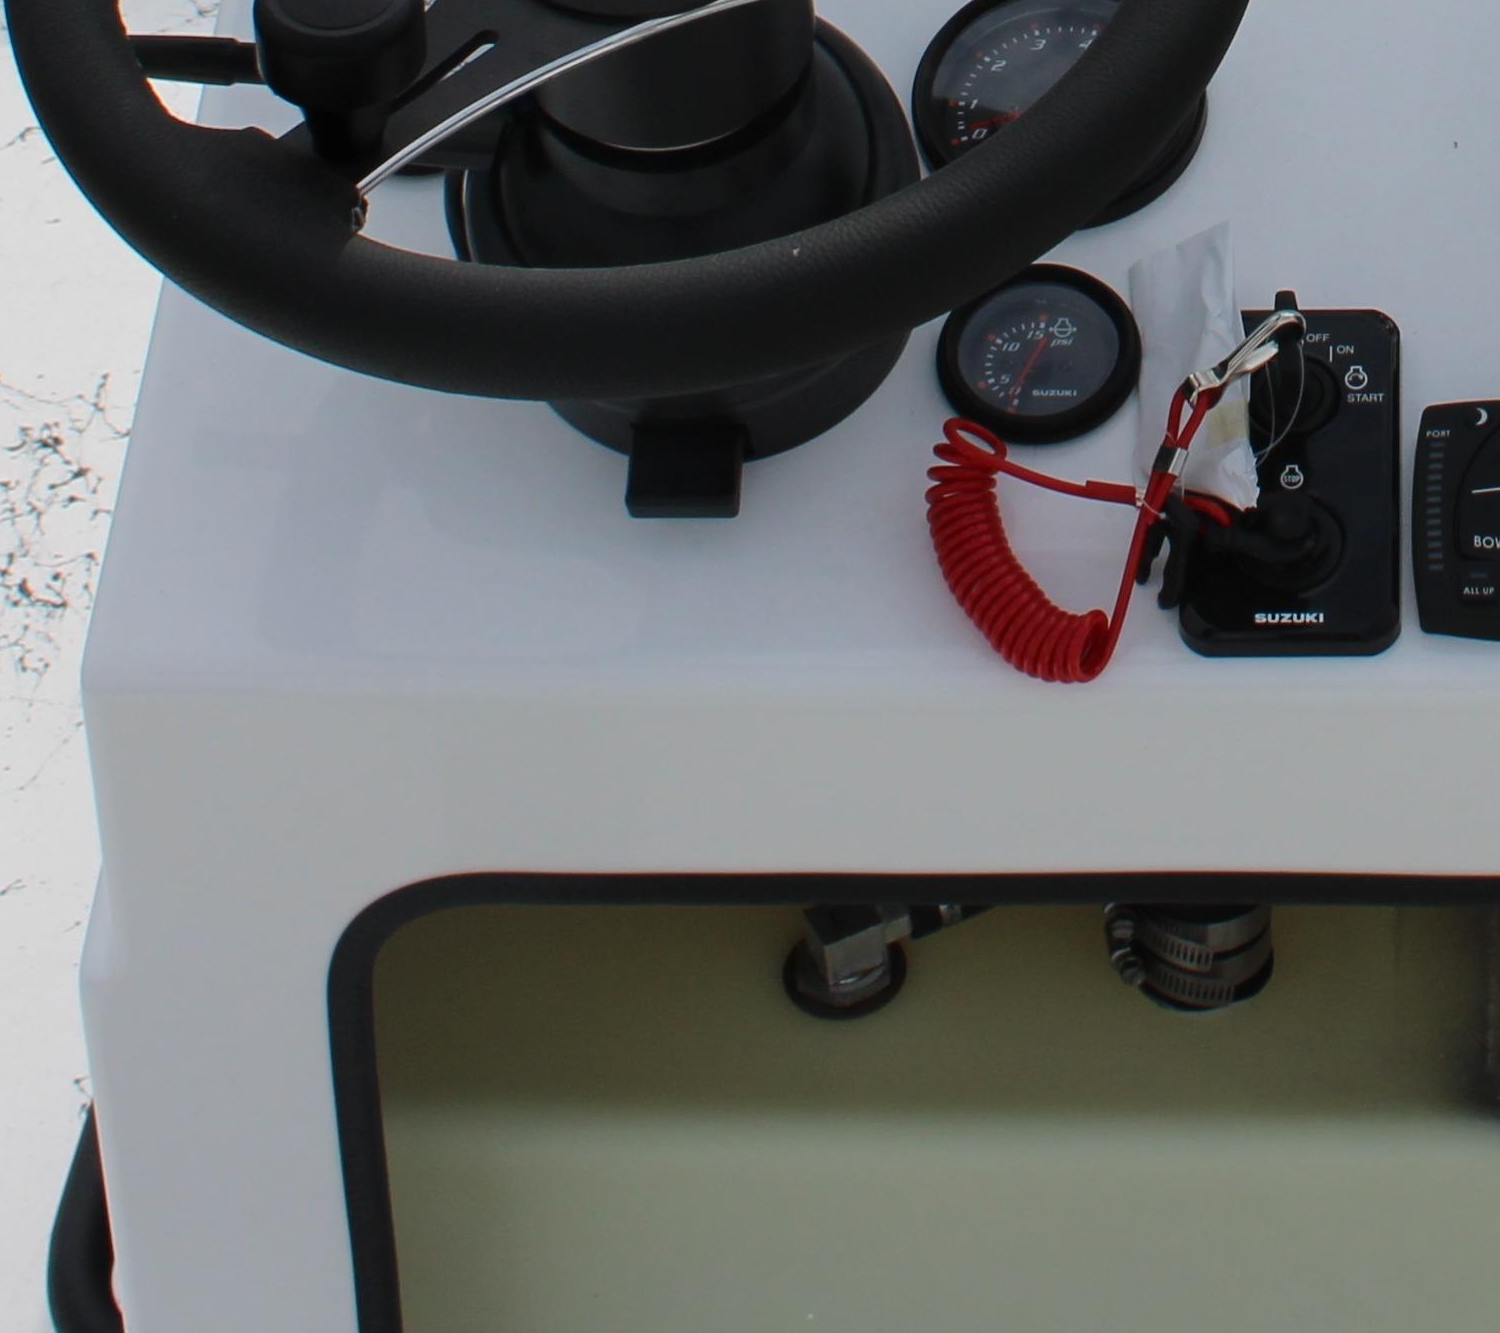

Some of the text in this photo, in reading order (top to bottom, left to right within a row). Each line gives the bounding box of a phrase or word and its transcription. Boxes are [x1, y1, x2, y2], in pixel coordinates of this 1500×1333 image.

[1030, 38, 1047, 52] 3
[991, 59, 1007, 73] 2
[969, 98, 979, 110] 1
[972, 127, 988, 140] 0
[1026, 330, 1046, 340] 15
[1306, 334, 1330, 343] OFF
[1002, 342, 1020, 352] 10
[1050, 338, 1074, 347] psi
[1336, 345, 1355, 355] ON
[1000, 374, 1011, 384] 5
[1031, 389, 1078, 397] SUZUKI
[1346, 393, 1385, 403] START
[1426, 430, 1451, 438] PORT
[1283, 475, 1301, 483] STOP
[1463, 587, 1495, 596] ALL UP
[1253, 611, 1325, 623] SUZUKI
